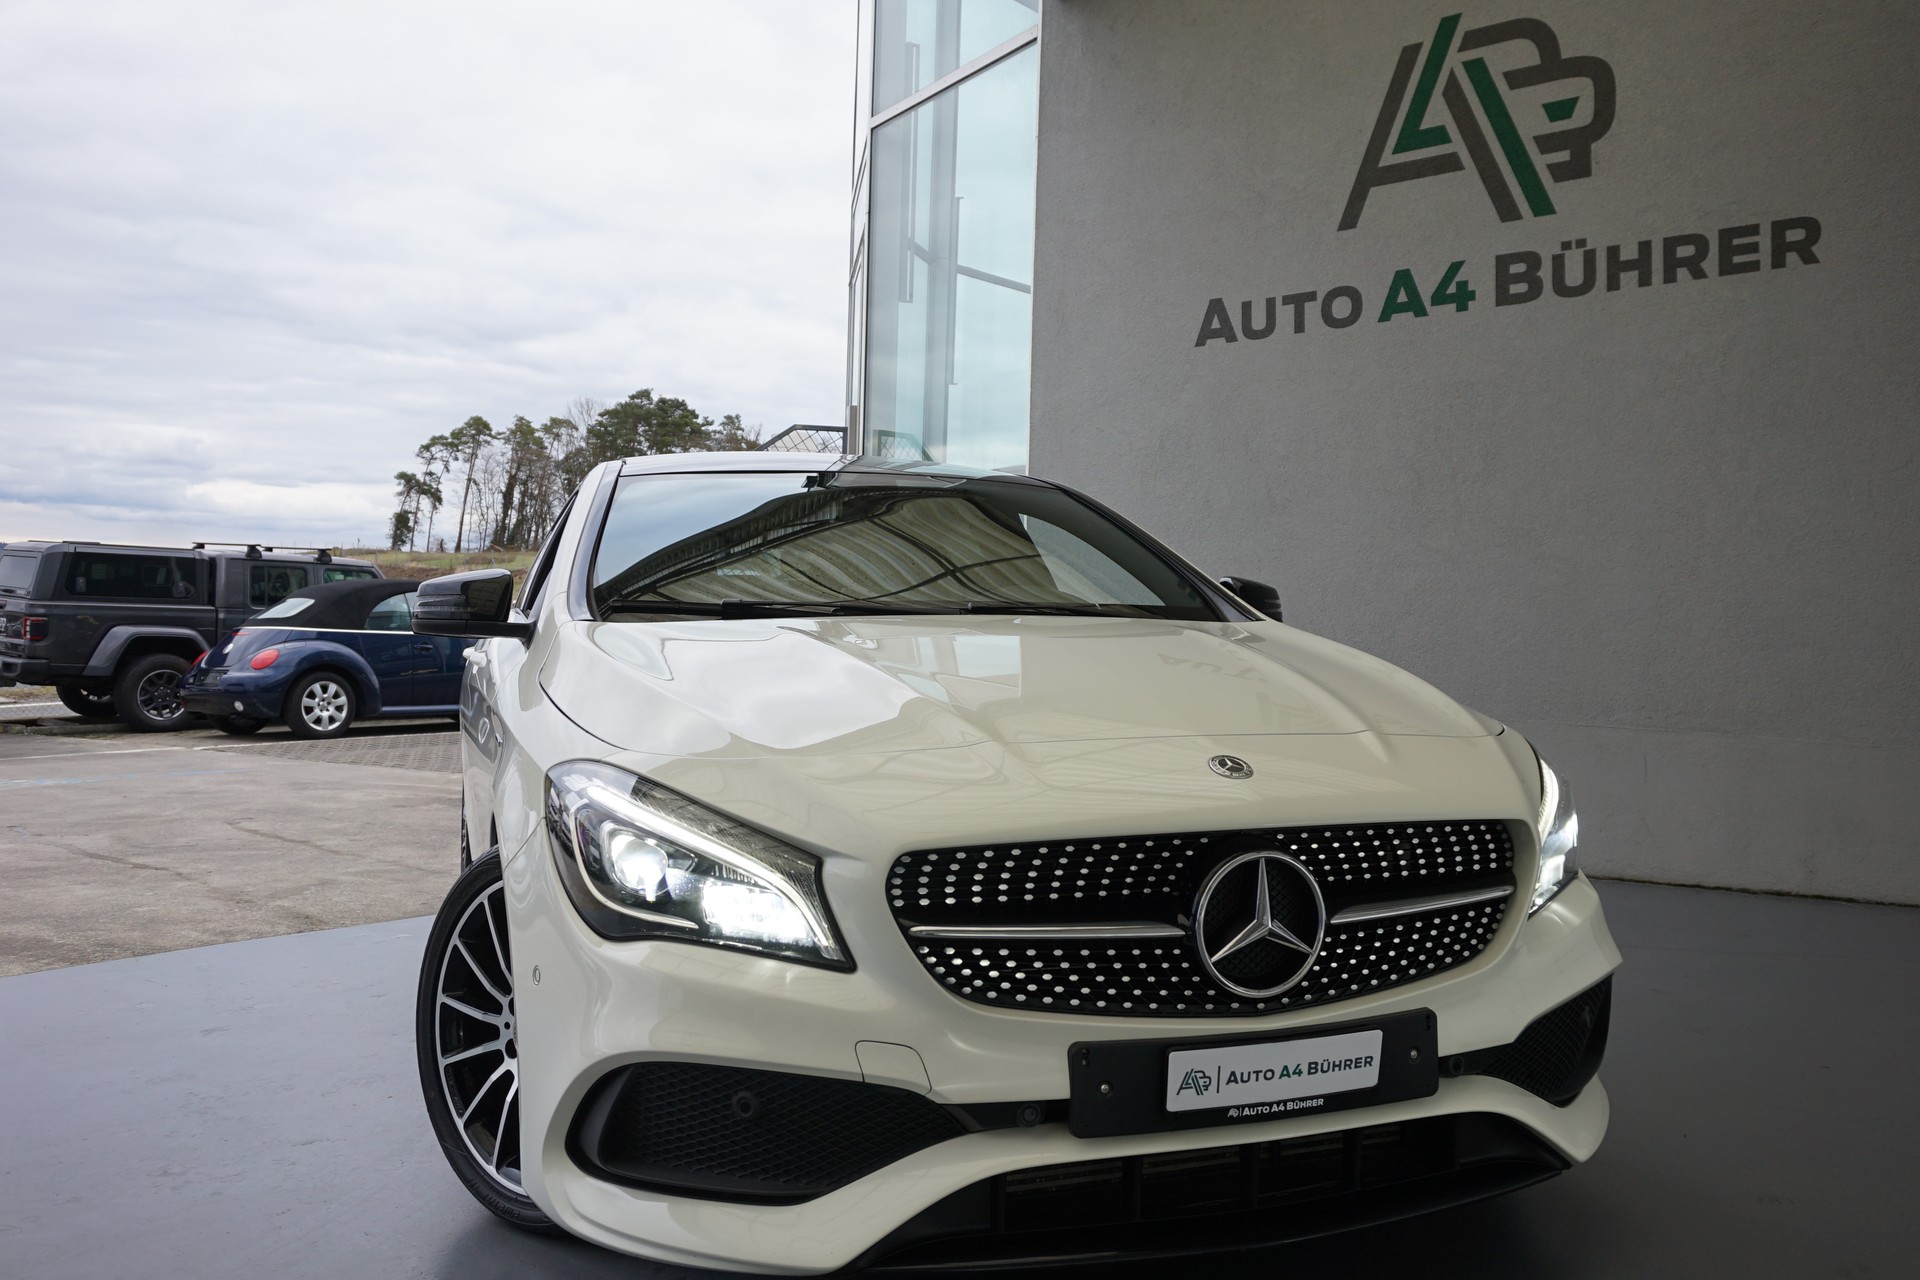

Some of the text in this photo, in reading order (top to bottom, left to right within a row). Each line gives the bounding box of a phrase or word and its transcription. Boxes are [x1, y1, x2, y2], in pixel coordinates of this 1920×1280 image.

[1194, 215, 1822, 348] AUTO A4 BÜHRER
[1225, 1068, 1276, 1086] AUTO
[1278, 1063, 1304, 1080] A4
[1306, 1055, 1374, 1077] BÜHRER
[1242, 1106, 1270, 1117] AUTO
[1271, 1102, 1285, 1113] A4
[1286, 1098, 1324, 1112] BÜHRER
